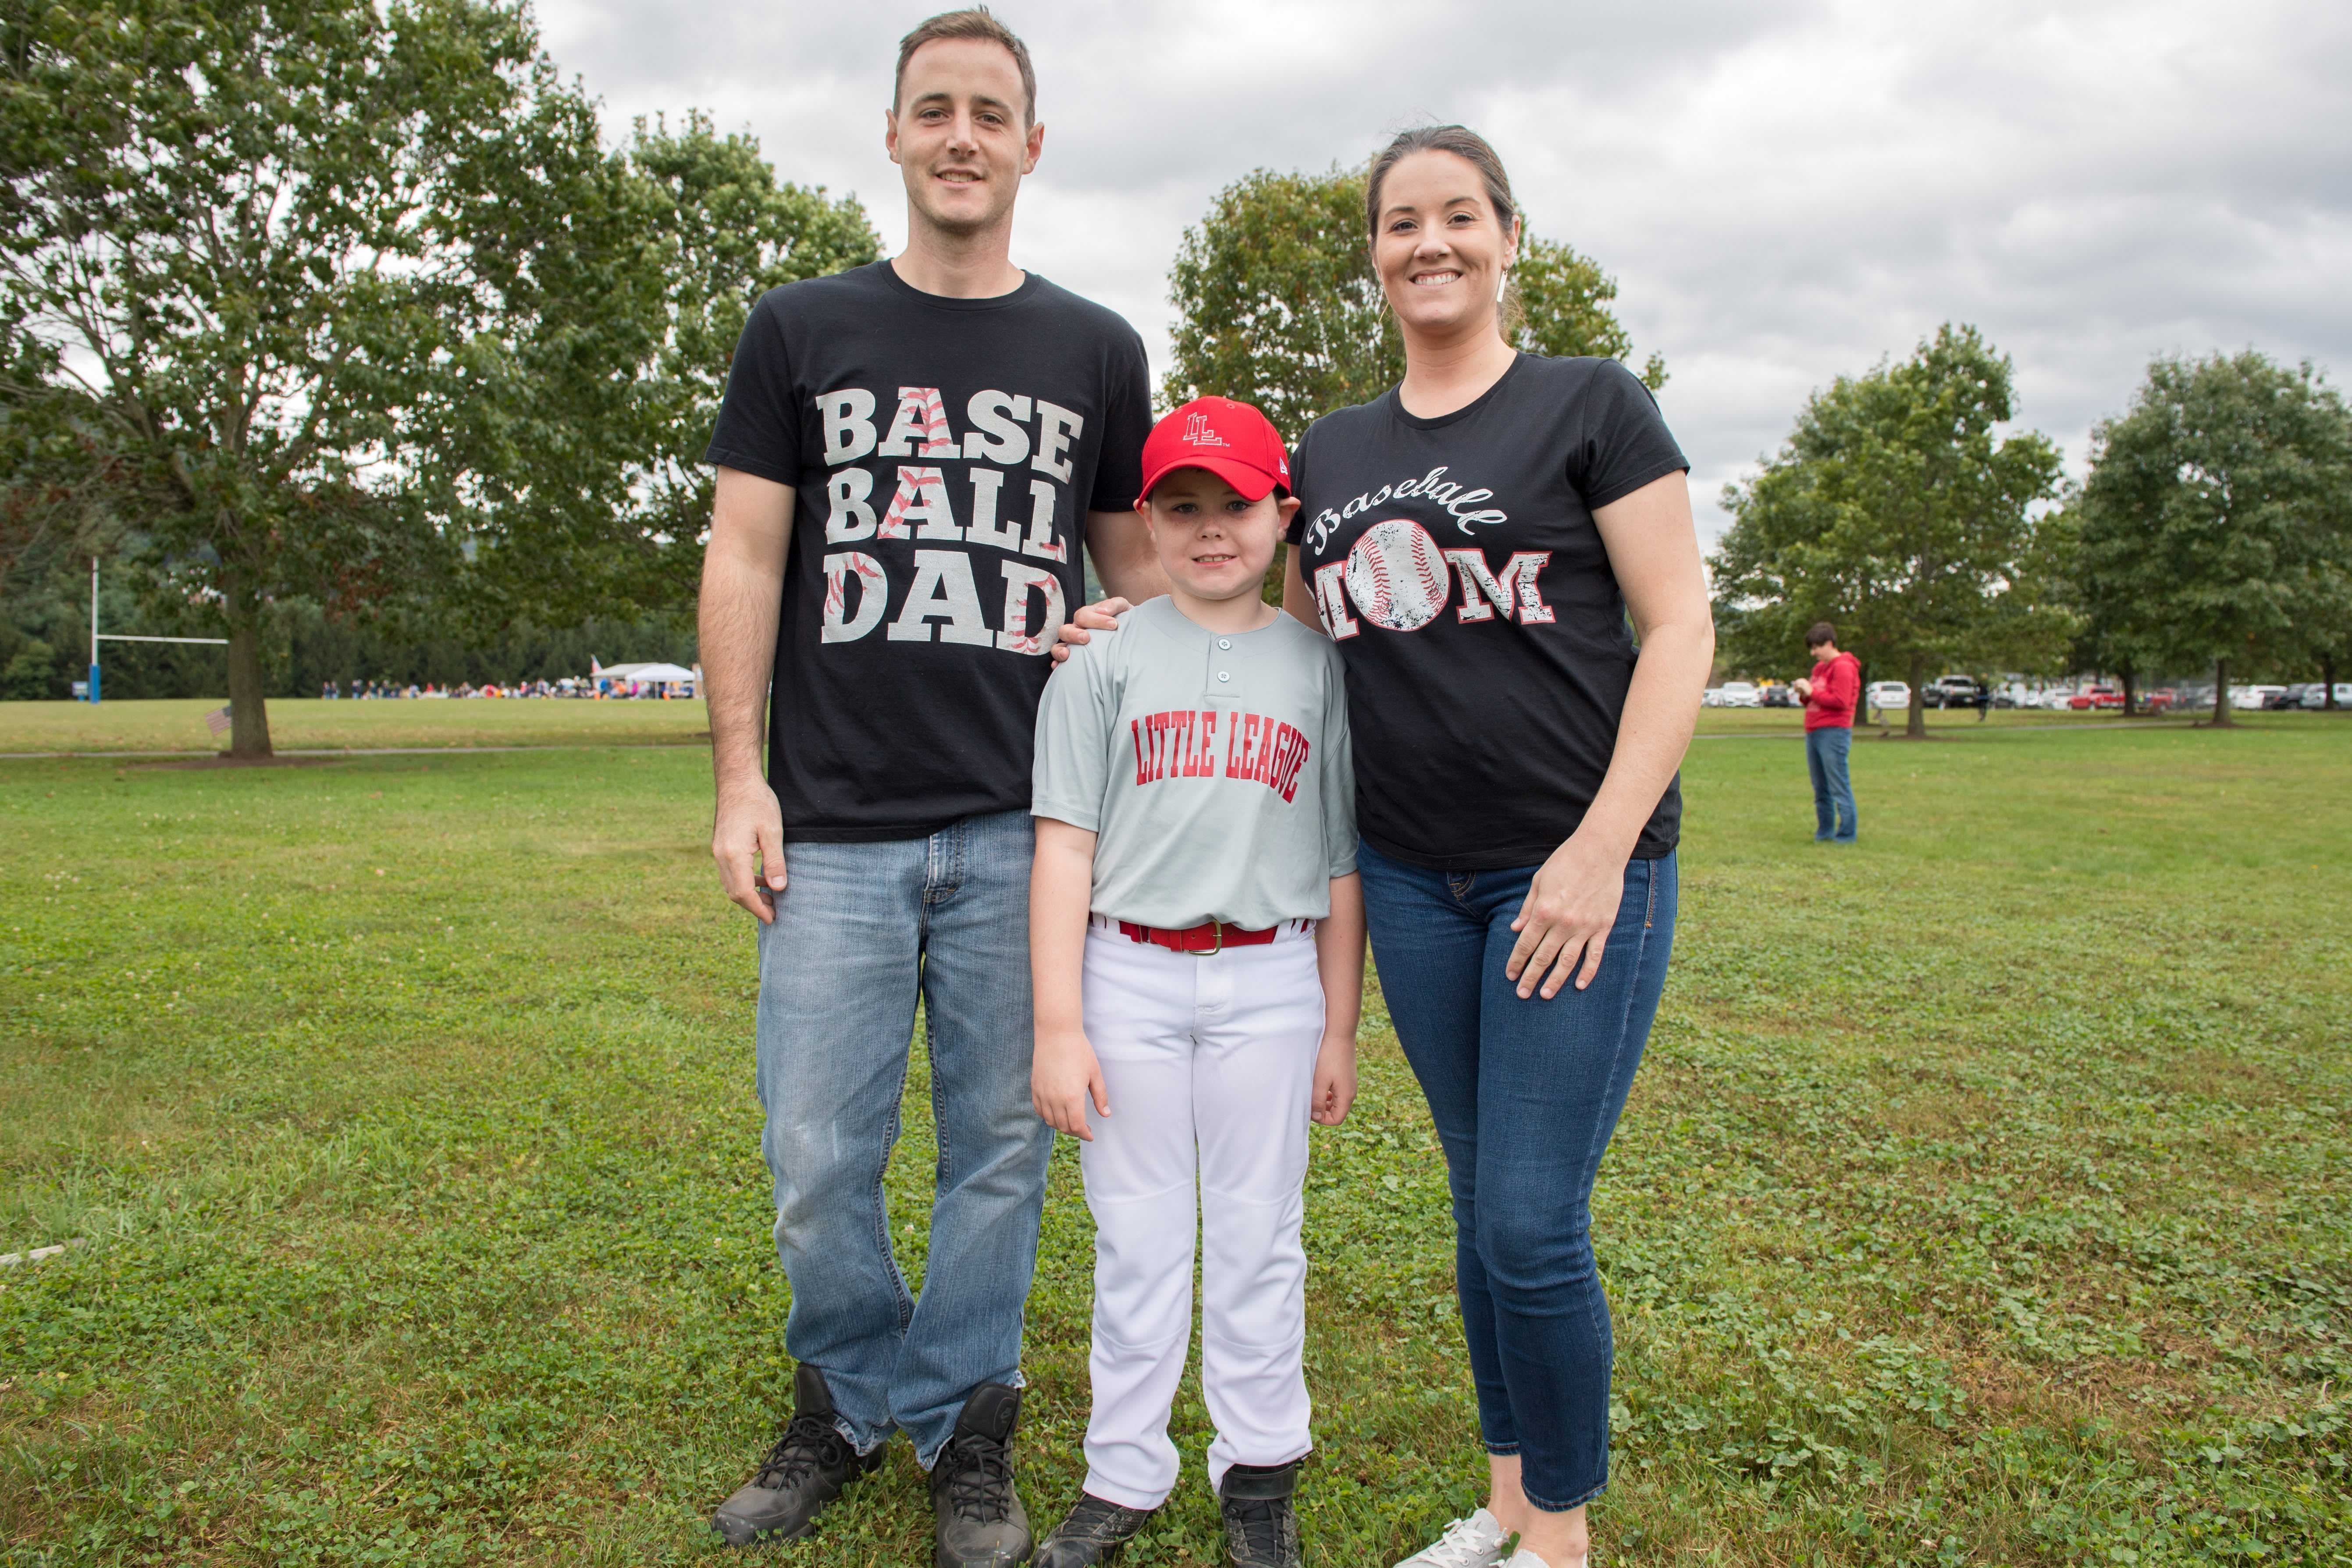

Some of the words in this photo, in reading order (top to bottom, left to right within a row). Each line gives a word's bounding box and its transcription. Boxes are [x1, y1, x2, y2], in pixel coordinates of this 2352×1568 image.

[815, 386, 1084, 485] BASE
[824, 466, 1067, 565] BALL
[1306, 466, 1508, 556] Baseball
[821, 550, 1066, 656] DAD
[1131, 710, 1217, 786] LITTLE
[1225, 711, 1310, 804] LEAGUE
